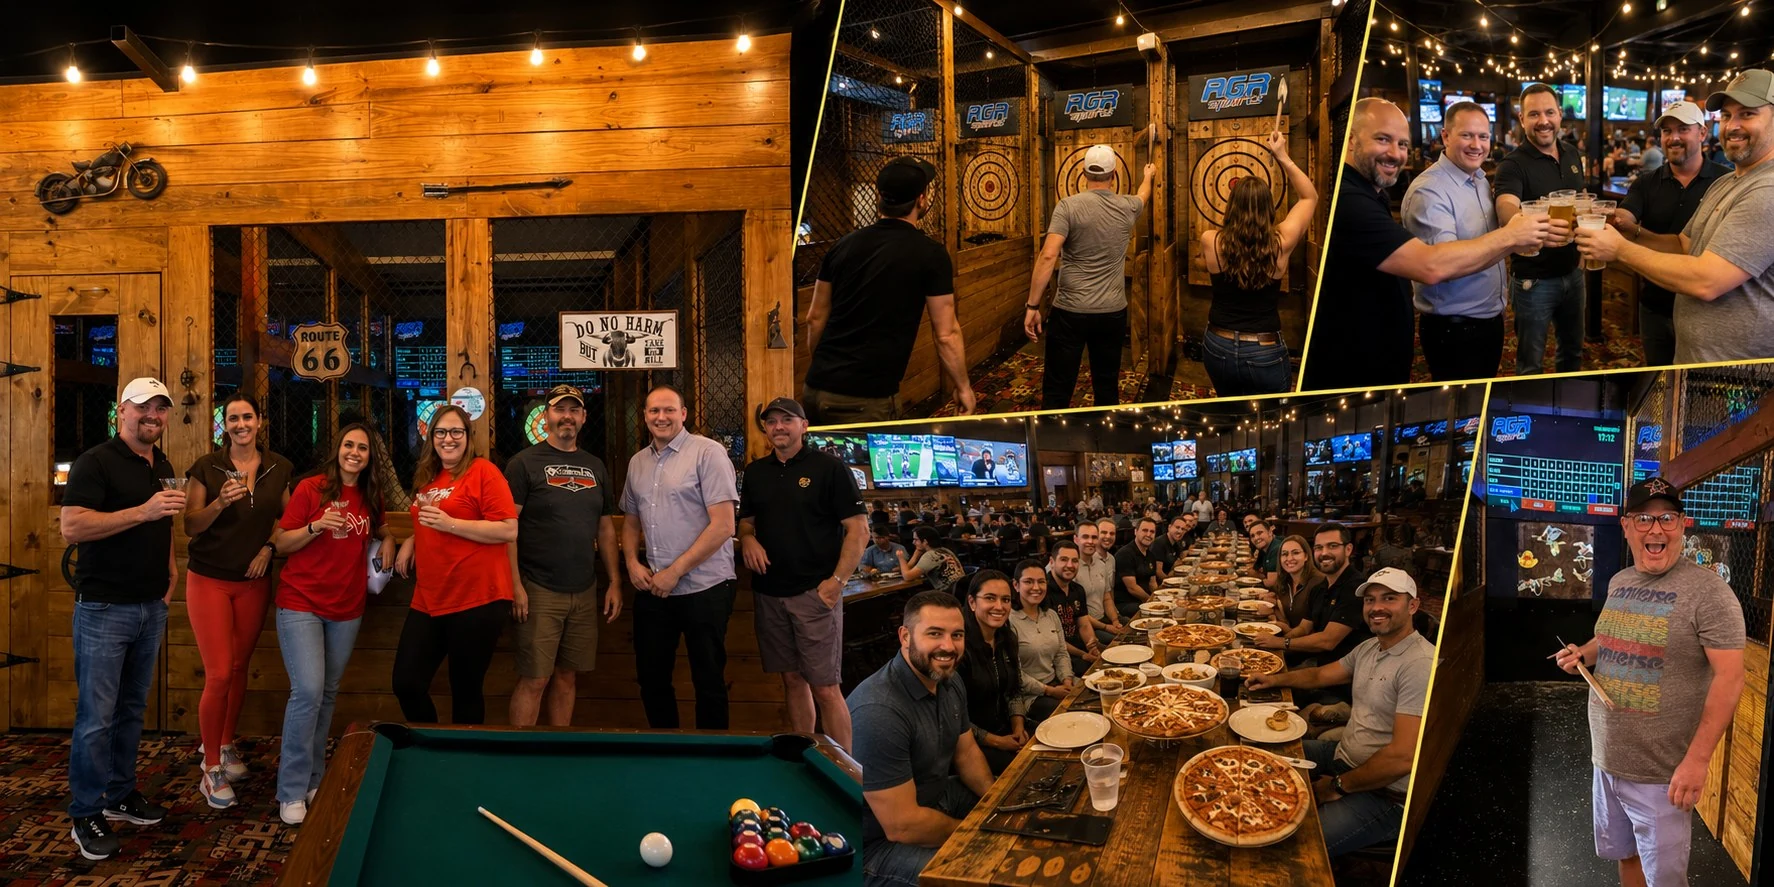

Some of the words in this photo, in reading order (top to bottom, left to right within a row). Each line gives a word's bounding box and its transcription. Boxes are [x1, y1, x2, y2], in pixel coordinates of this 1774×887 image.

[301, 331, 340, 342] ROUTE
[576, 320, 594, 339] DO
[600, 316, 618, 332] NO
[626, 316, 664, 337] HARM
[302, 348, 340, 371] 66
[580, 341, 597, 360] BUT
